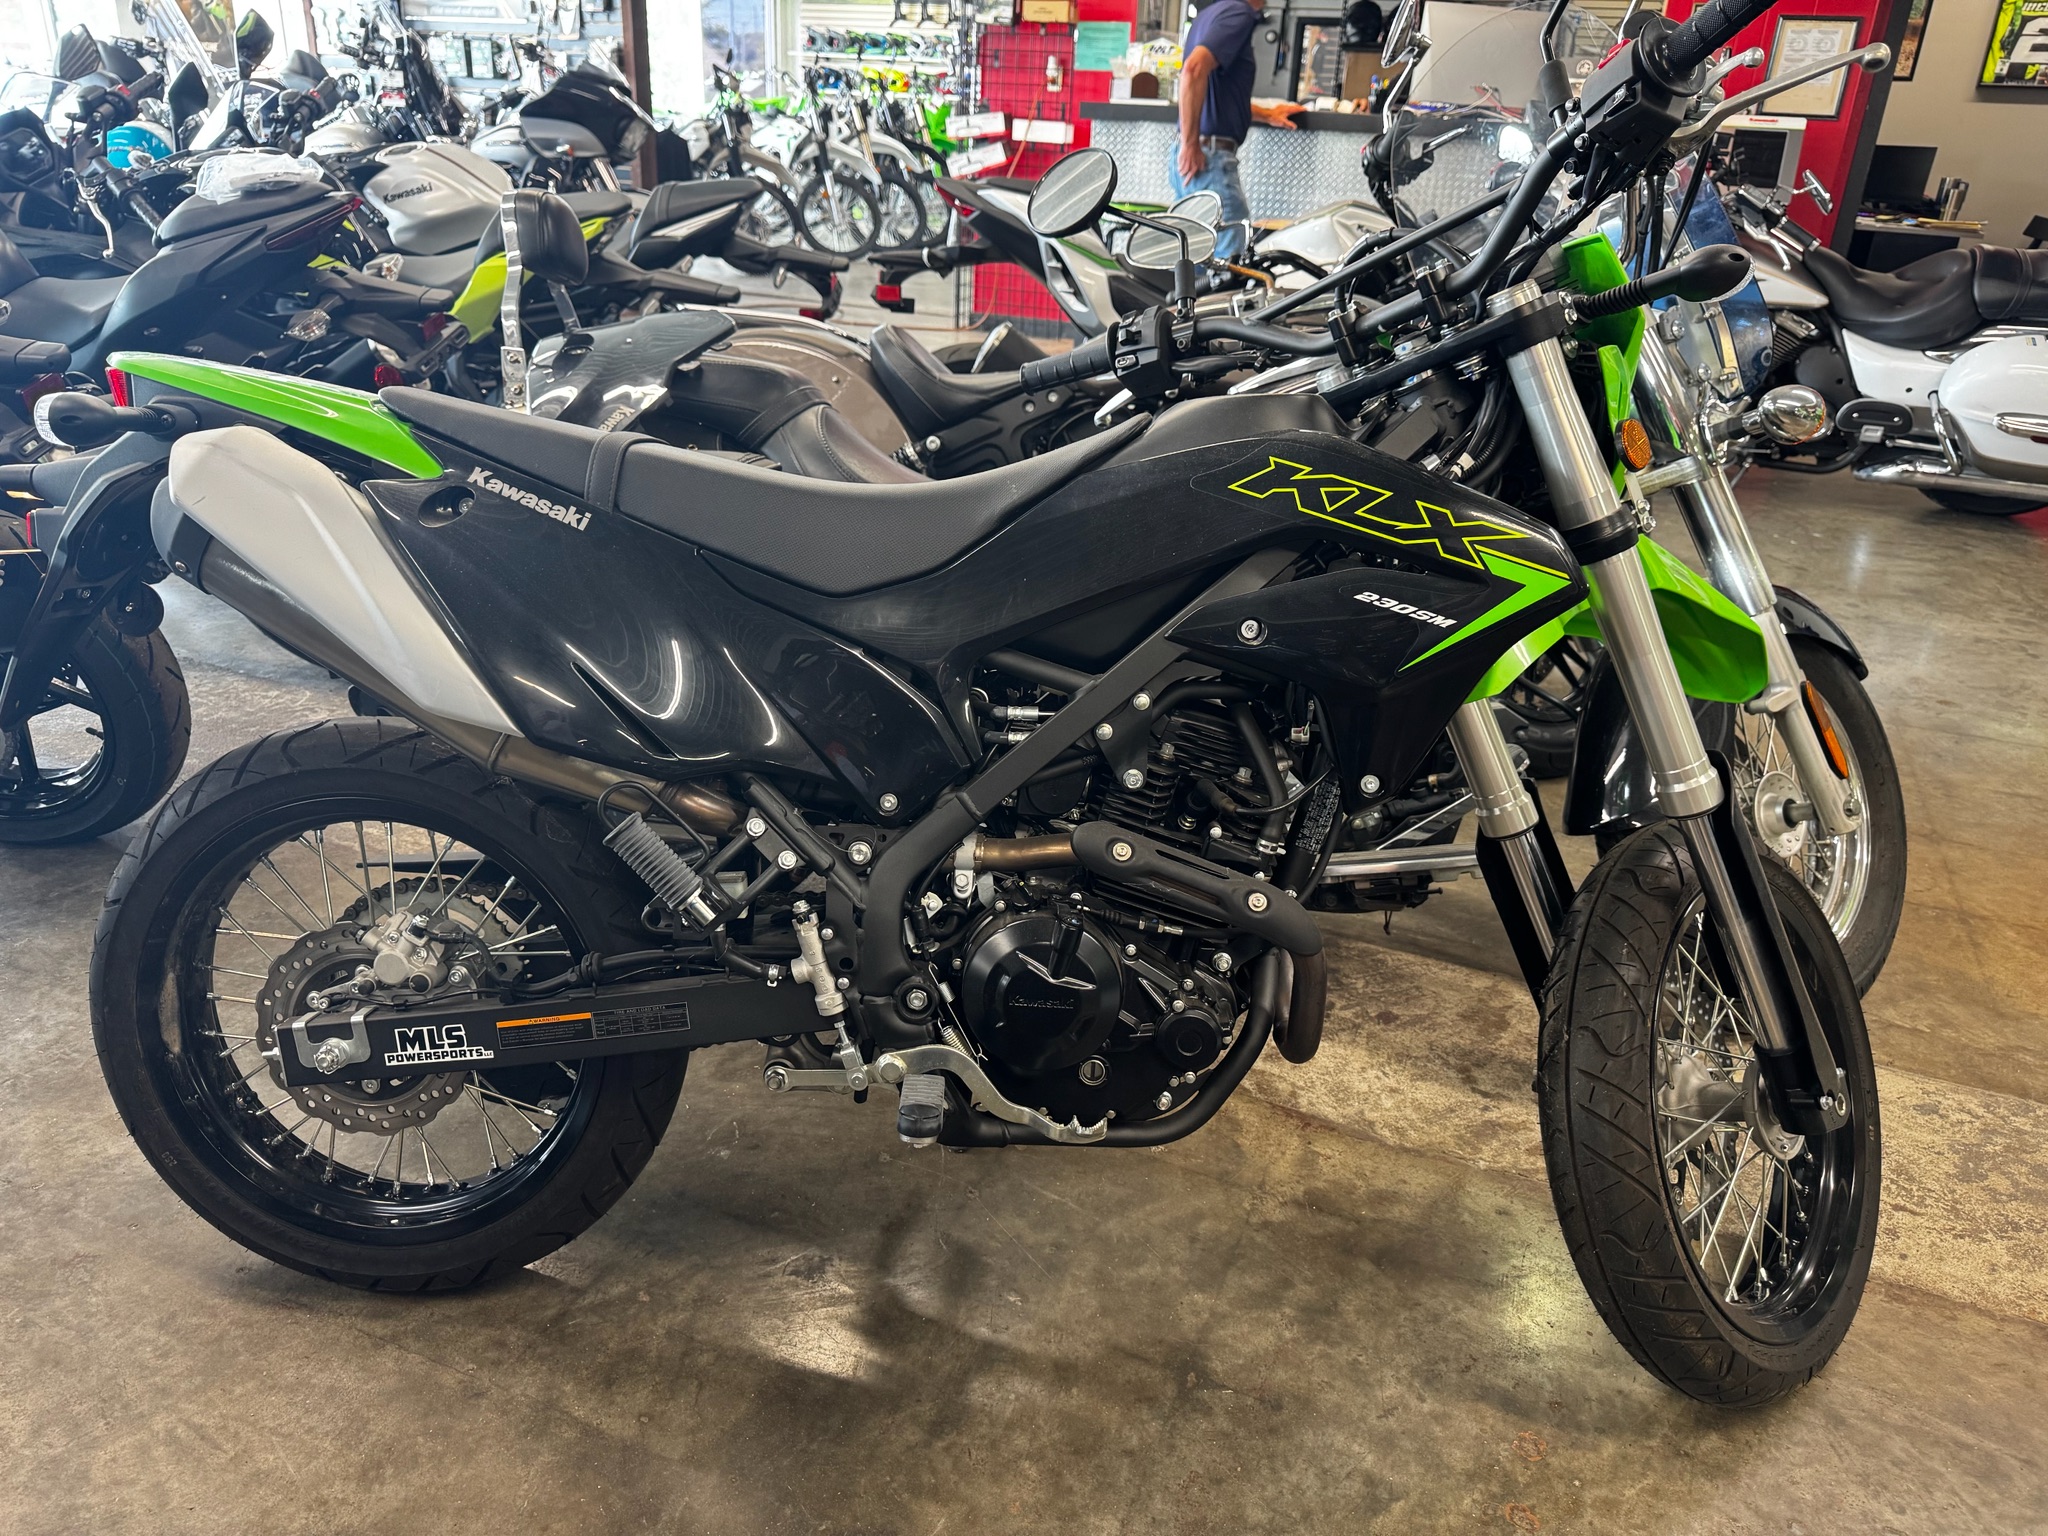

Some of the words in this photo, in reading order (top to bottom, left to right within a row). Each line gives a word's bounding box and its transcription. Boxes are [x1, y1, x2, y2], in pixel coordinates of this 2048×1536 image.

[382, 182, 433, 204] Kawasaki
[467, 466, 592, 531] Kawasaki
[1228, 456, 1531, 570] KLX
[1353, 591, 1458, 628] 230SM
[1009, 995, 1074, 1010] Kawasaki
[396, 1025, 466, 1052] MLS
[386, 1048, 483, 1064] POWERSPORTS
